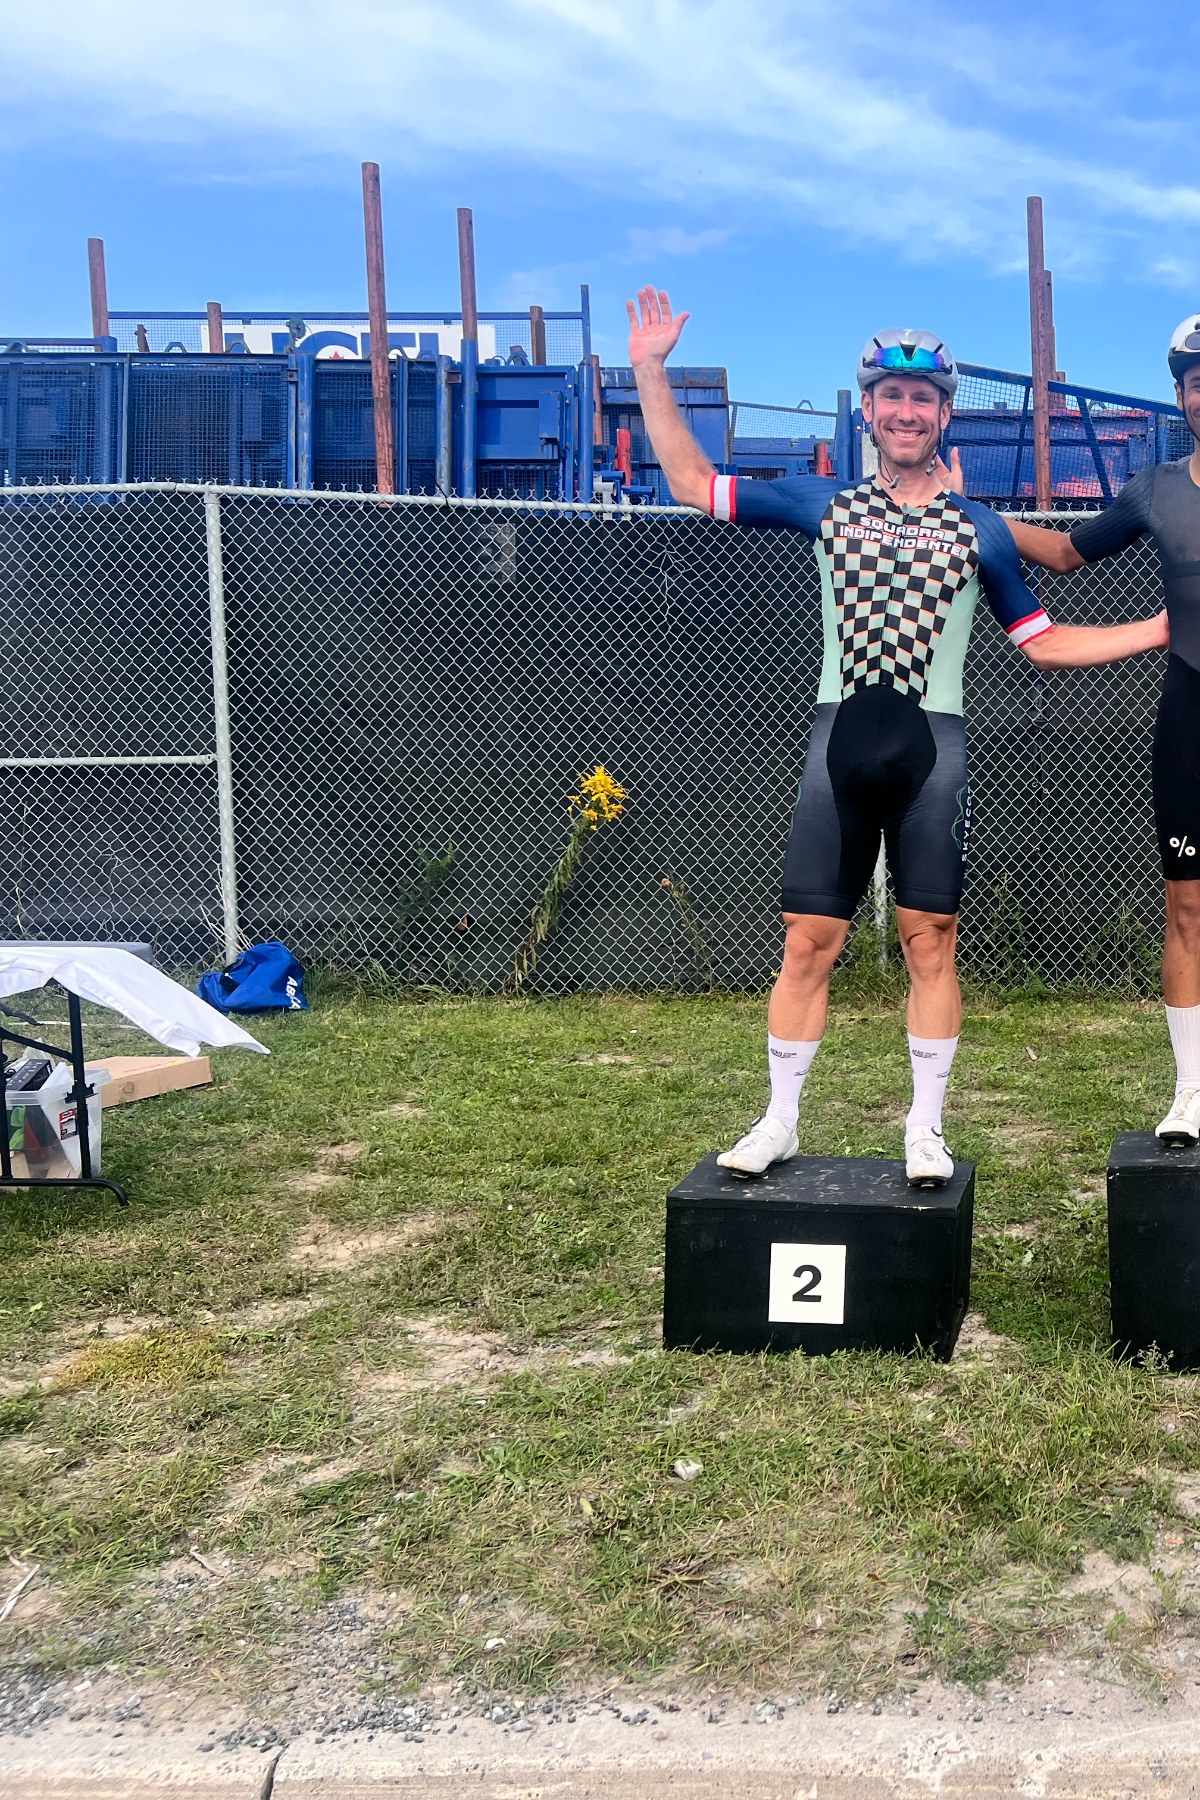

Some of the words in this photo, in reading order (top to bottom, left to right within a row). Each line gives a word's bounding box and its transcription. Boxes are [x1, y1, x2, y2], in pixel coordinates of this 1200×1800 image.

[839, 525, 962, 557] INDIPENDENTE
[859, 516, 945, 539] SQUADRA
[791, 1265, 823, 1303] 2
